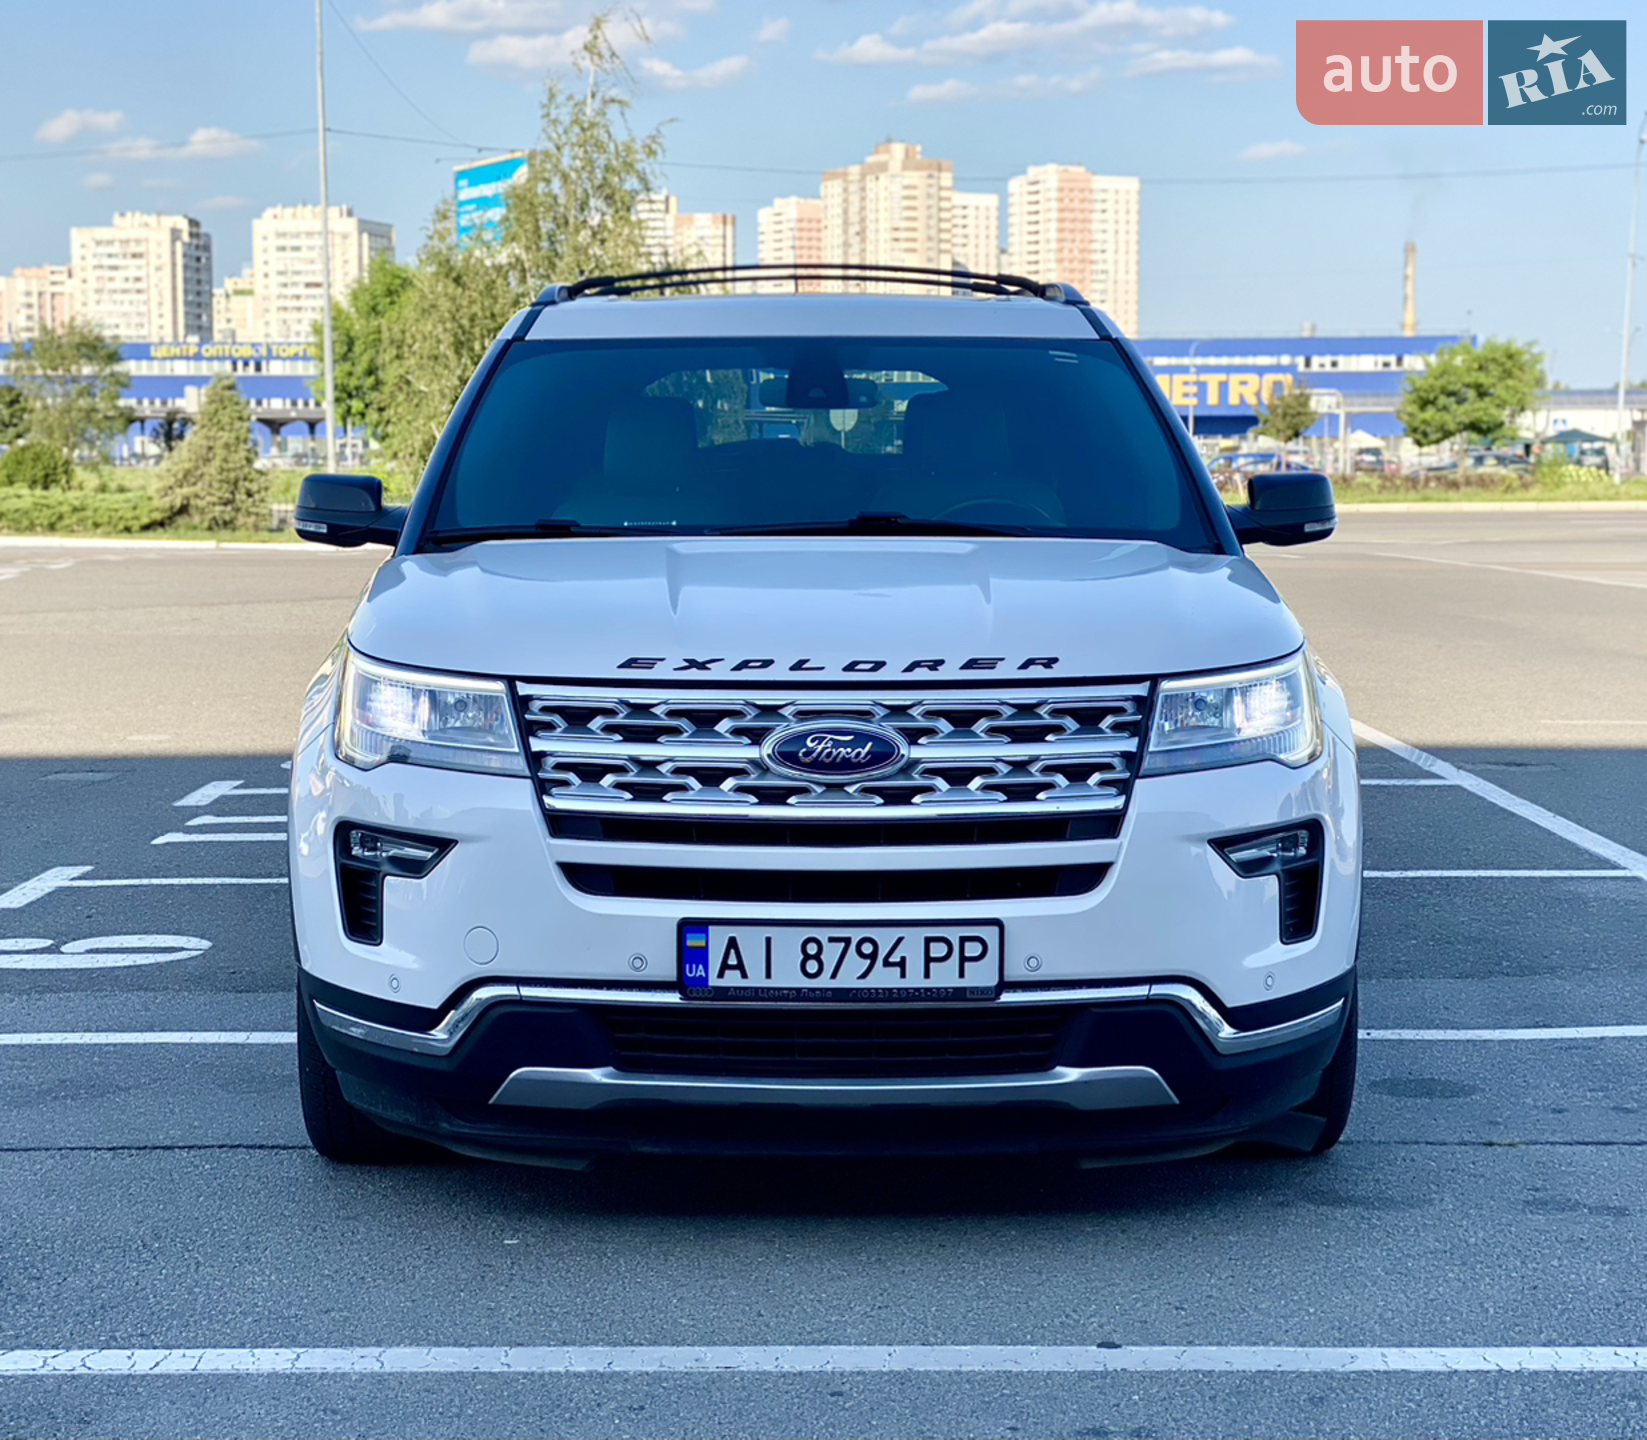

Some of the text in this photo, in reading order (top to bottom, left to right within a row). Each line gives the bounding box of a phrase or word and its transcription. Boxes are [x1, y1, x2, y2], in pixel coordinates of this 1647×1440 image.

[151, 344, 199, 358] ЦЕНТР
[616, 656, 1060, 673] EXPLORER
[798, 733, 873, 763] Ford
[716, 935, 989, 980] AI 8794 PP
[686, 963, 706, 978] UA
[727, 988, 755, 997] Audi
